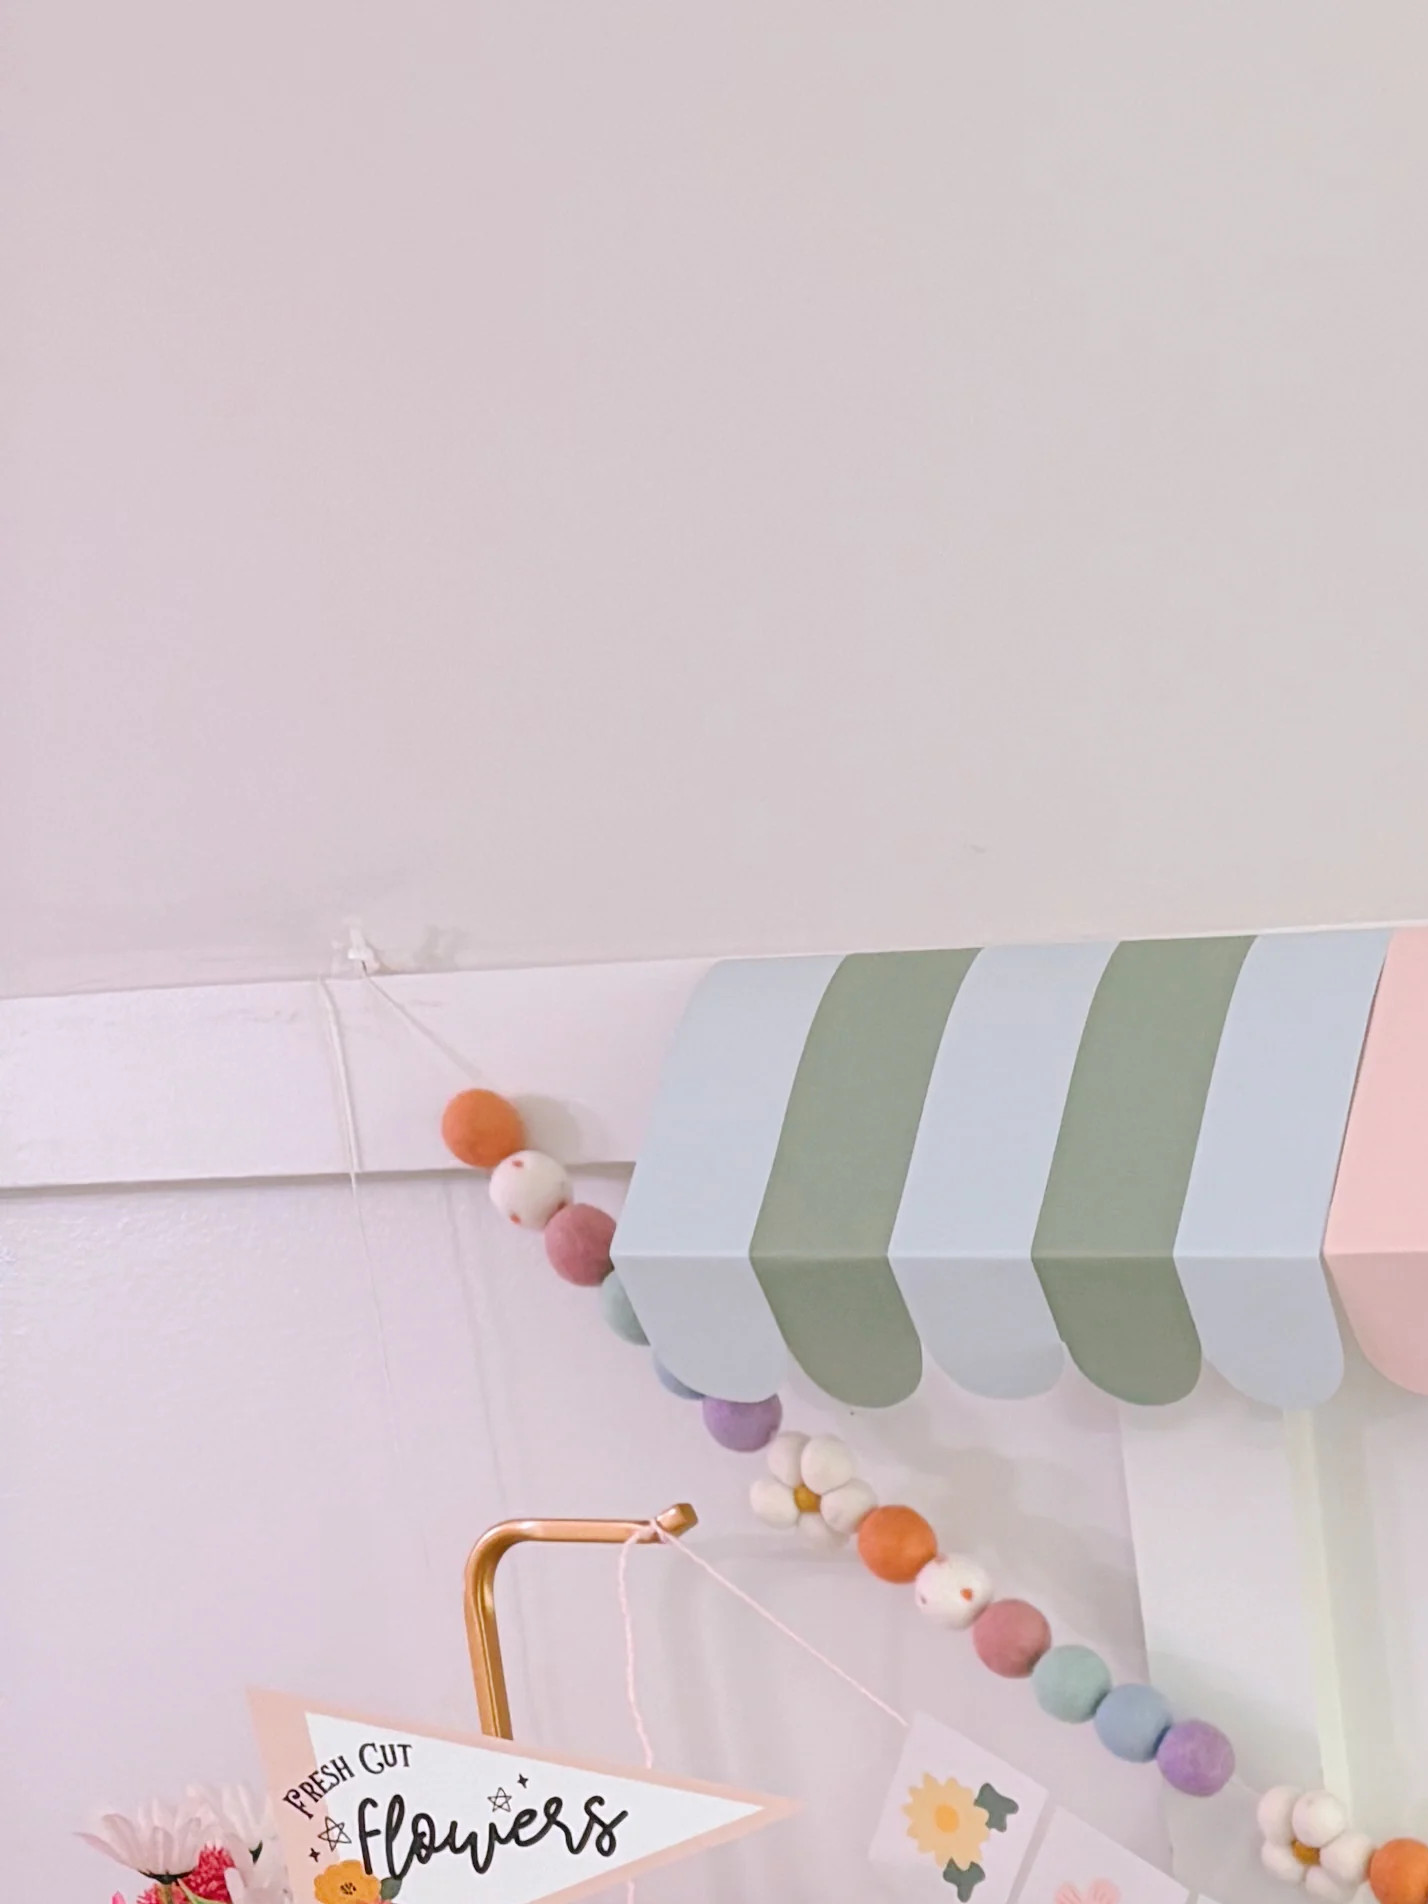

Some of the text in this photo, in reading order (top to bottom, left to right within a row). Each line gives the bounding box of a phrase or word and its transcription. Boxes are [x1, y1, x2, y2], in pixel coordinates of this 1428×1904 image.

[282, 1742, 413, 1820] FRESH CUT
[356, 1793, 630, 1882] flowers
